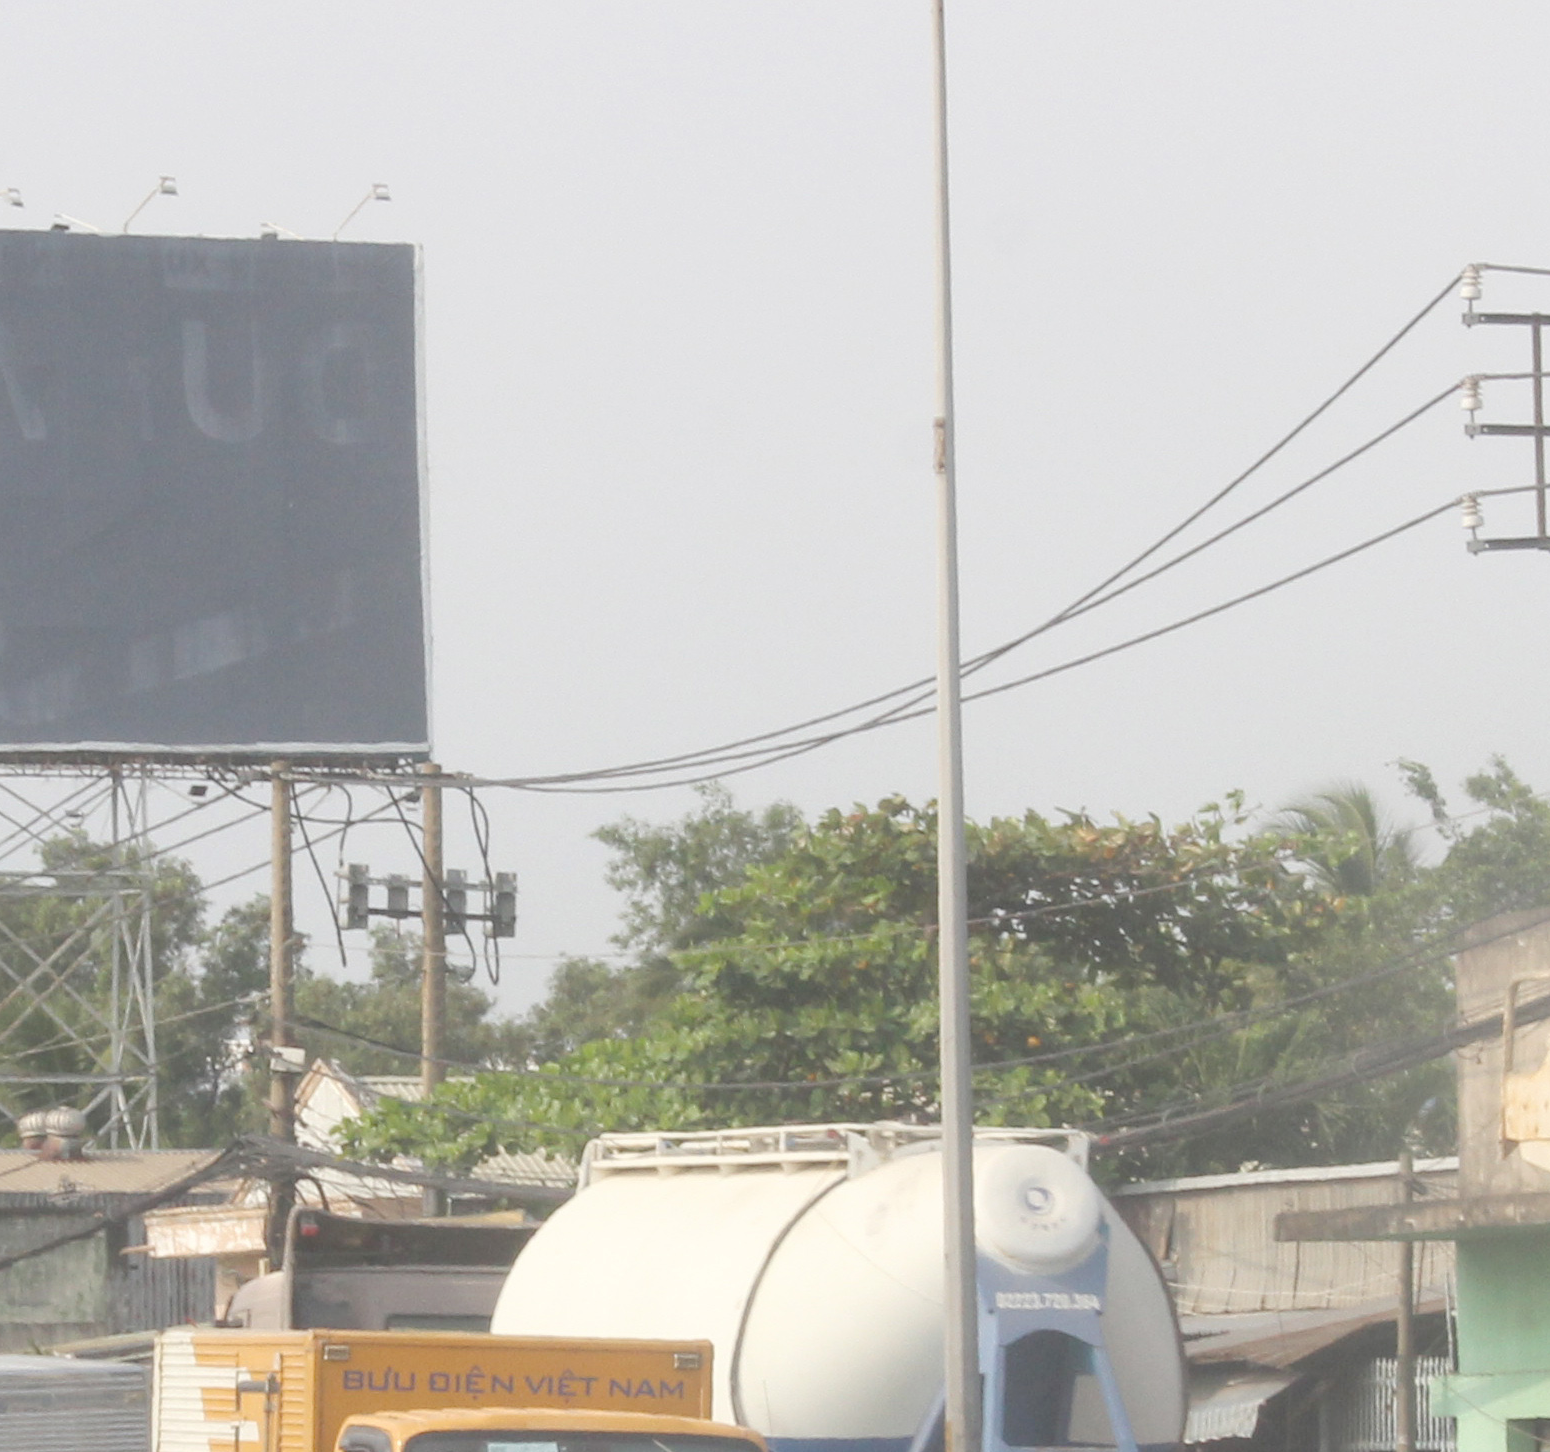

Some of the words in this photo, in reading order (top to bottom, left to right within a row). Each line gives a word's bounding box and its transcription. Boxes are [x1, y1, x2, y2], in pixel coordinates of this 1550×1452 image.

[343, 1366, 416, 1392] BƯU
[428, 1366, 515, 1400] ĐIỆN
[524, 1369, 598, 1403] VIỆT
[608, 1378, 685, 1399] NAM
